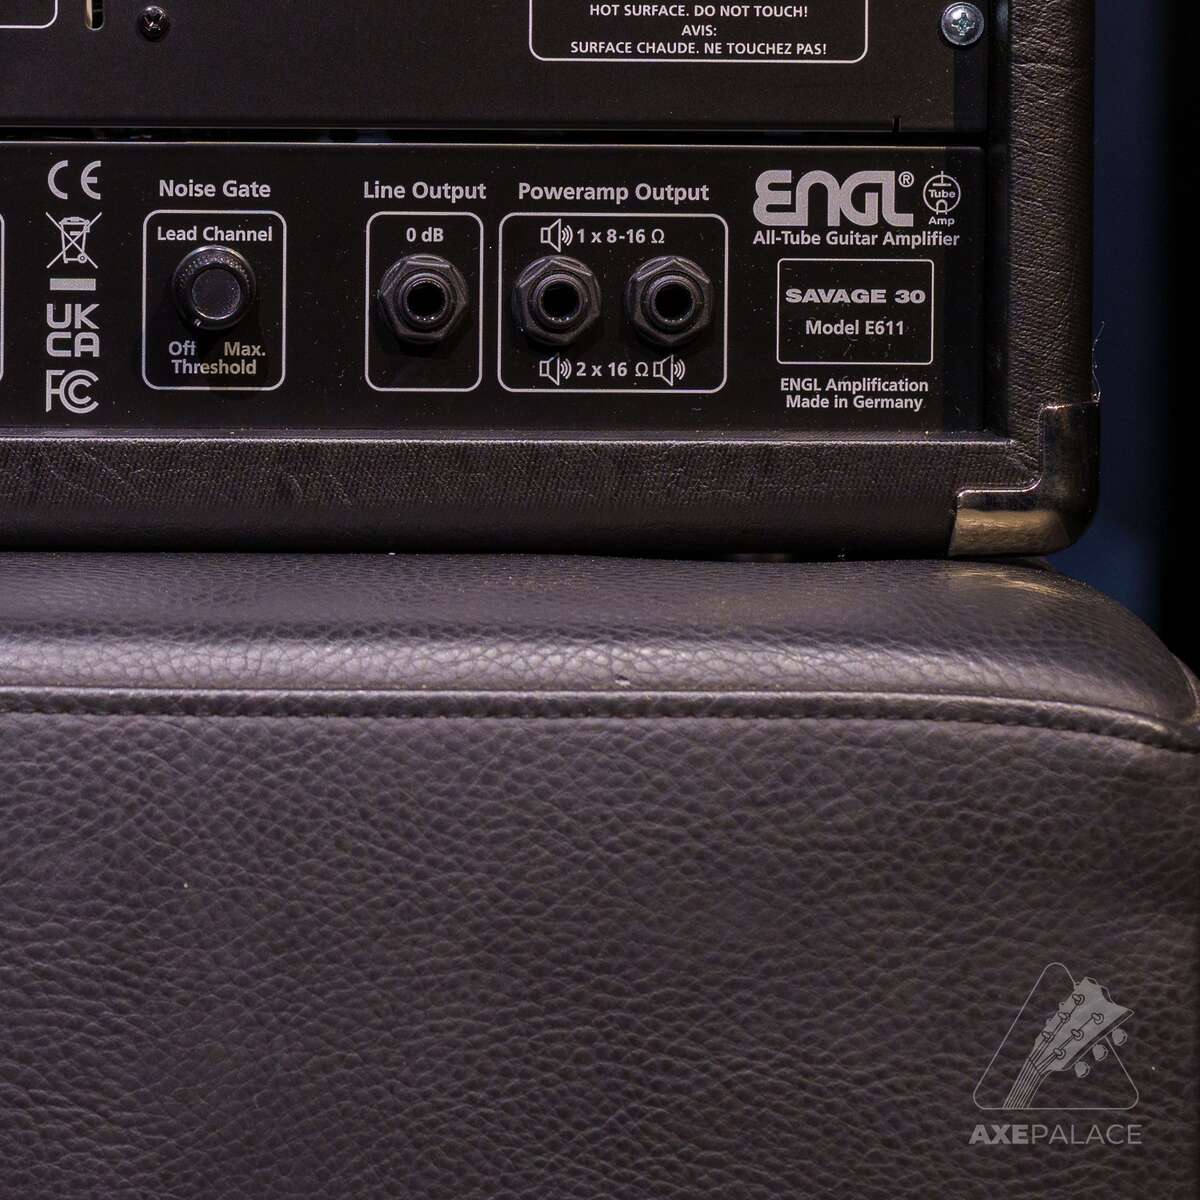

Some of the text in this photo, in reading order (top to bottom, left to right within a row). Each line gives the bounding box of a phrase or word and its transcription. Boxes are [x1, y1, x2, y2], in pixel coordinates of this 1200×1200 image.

[590, 4, 807, 17] HOT SURFACE. DO NOT TOUCH!
[681, 24, 716, 36] AVIS:
[570, 41, 826, 55] SURFACE CHAUDE. NE TOUCHEZ PAS!
[47, 159, 101, 200] CE
[159, 178, 270, 197] Noise Gate
[363, 180, 486, 203] Line Output
[518, 182, 709, 205] Poweramp Output
[928, 189, 956, 198] Tube
[928, 216, 955, 227] Amp
[157, 225, 272, 241] Lead Channel
[406, 226, 444, 242] 0 dB
[576, 228, 584, 243] 1
[590, 231, 602, 243] x
[606, 228, 645, 243] 8-16
[752, 229, 960, 249] All-Tube Guitar Amplifier
[785, 288, 926, 303] SAVAGE 30
[805, 319, 903, 335] Model E611
[168, 340, 196, 355] Off
[224, 341, 266, 356] Max.
[170, 358, 256, 374] Threshold
[576, 361, 586, 376] 2
[590, 365, 602, 376] x
[608, 361, 627, 376] 16
[780, 377, 928, 395] ENGL Amplification
[786, 393, 923, 412] Made in Germany
